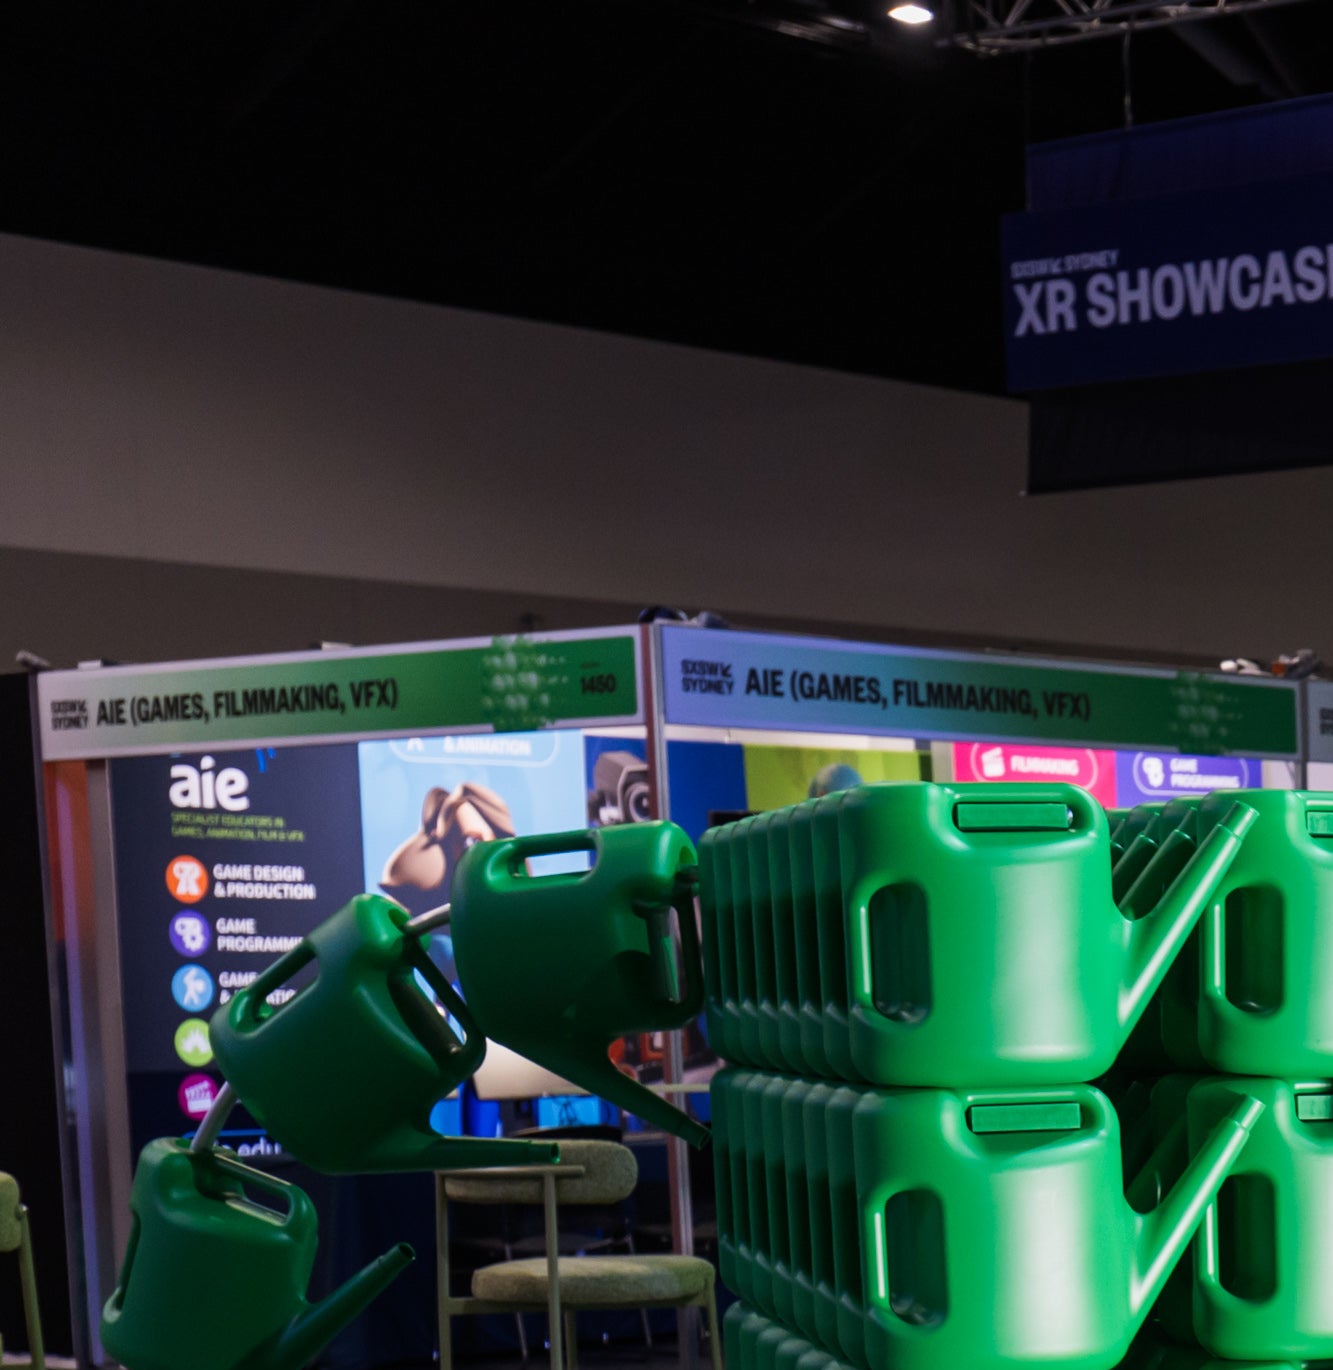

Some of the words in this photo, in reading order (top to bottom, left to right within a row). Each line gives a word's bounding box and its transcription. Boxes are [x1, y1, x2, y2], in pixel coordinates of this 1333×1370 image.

[1013, 279, 1077, 337] XR
[682, 677, 734, 694] SYDNEY
[745, 668, 785, 697] AIE
[790, 671, 888, 710] (GAMES,
[893, 679, 1038, 720] FILMMAKING,
[1043, 691, 1091, 721] VFX)
[97, 700, 126, 726] AIE
[130, 692, 209, 727] (GAMES,
[213, 681, 346, 719] FILMMAKING,
[349, 677, 398, 710] VFX)
[169, 755, 249, 812] aie
[213, 863, 252, 881] GAME
[253, 864, 305, 883] DESIGN
[226, 882, 316, 900] PRODUCTION
[216, 917, 256, 935] GAME
[217, 935, 304, 953] PROGRAMM
